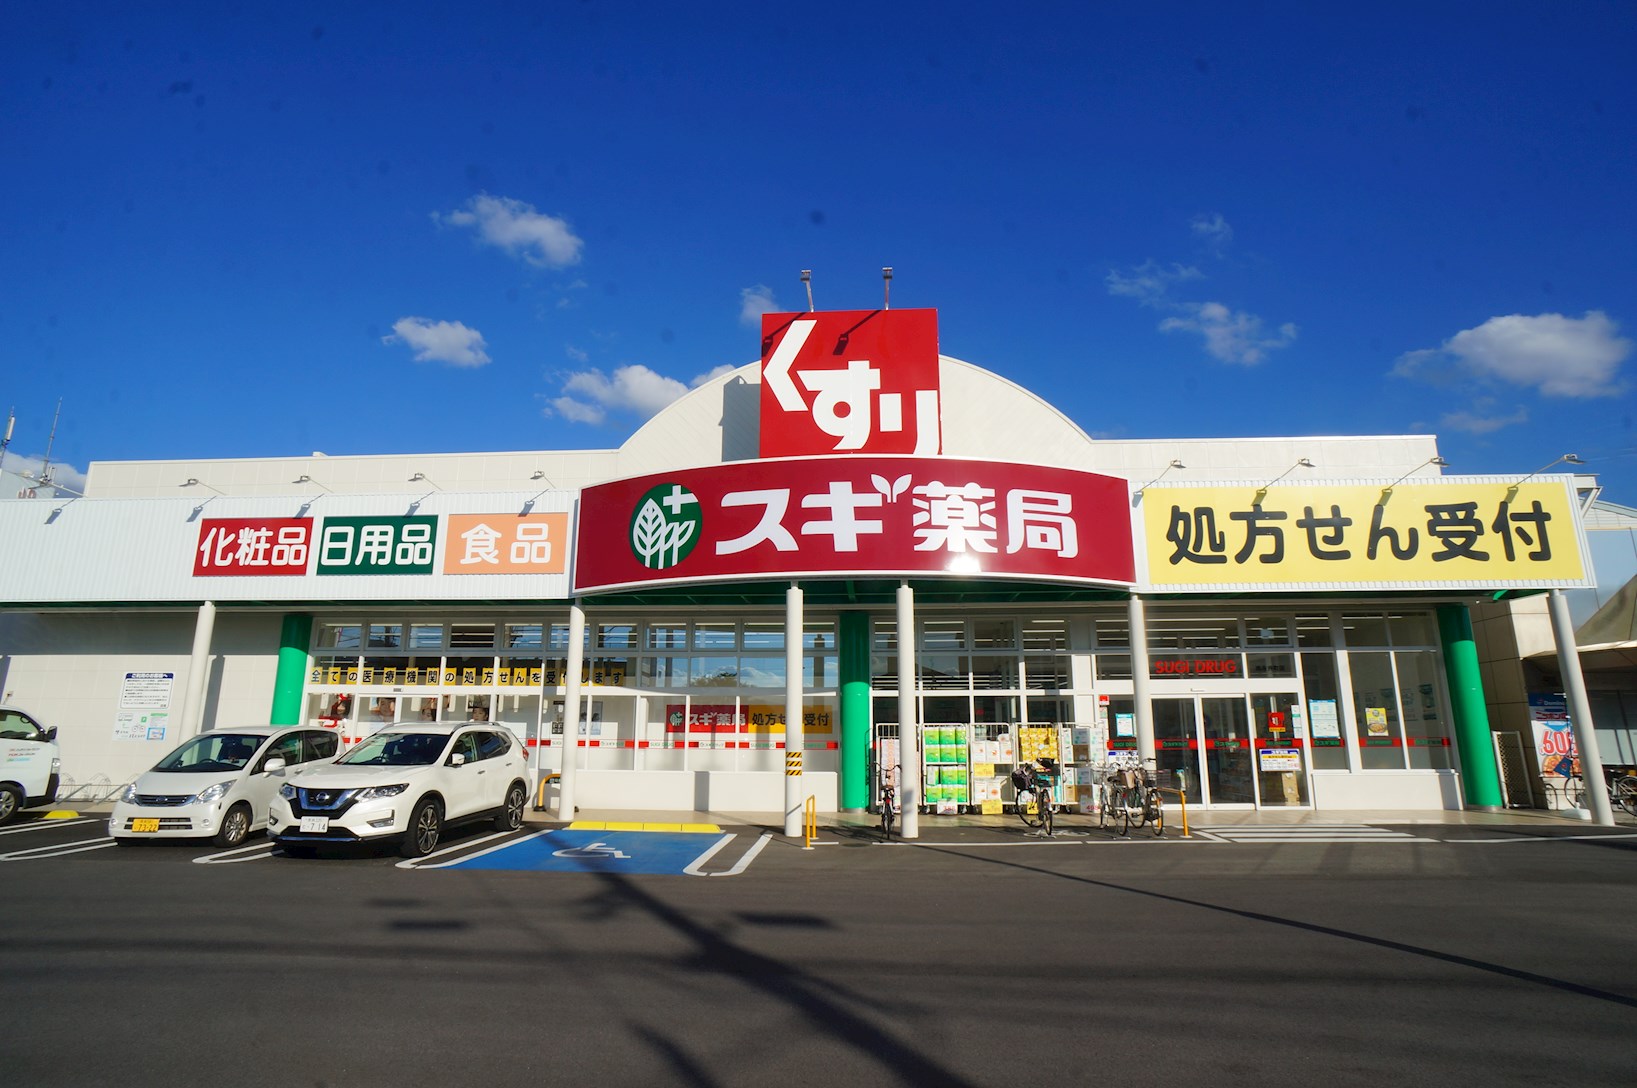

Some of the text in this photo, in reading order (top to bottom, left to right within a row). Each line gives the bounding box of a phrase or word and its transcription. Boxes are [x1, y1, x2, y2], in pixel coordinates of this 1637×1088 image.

[763, 320, 938, 455] くすり
[715, 473, 1079, 559] スギ薬局
[1166, 500, 1552, 566] 処方せん受付
[200, 526, 307, 568] 化粧品
[320, 523, 432, 566] 日用品
[460, 522, 552, 564] 食品
[311, 669, 623, 684] 全ての医療機関の処方せんを受します
[1154, 659, 1237, 674] SUGI DRUG
[752, 713, 829, 726] 処方せ受付
